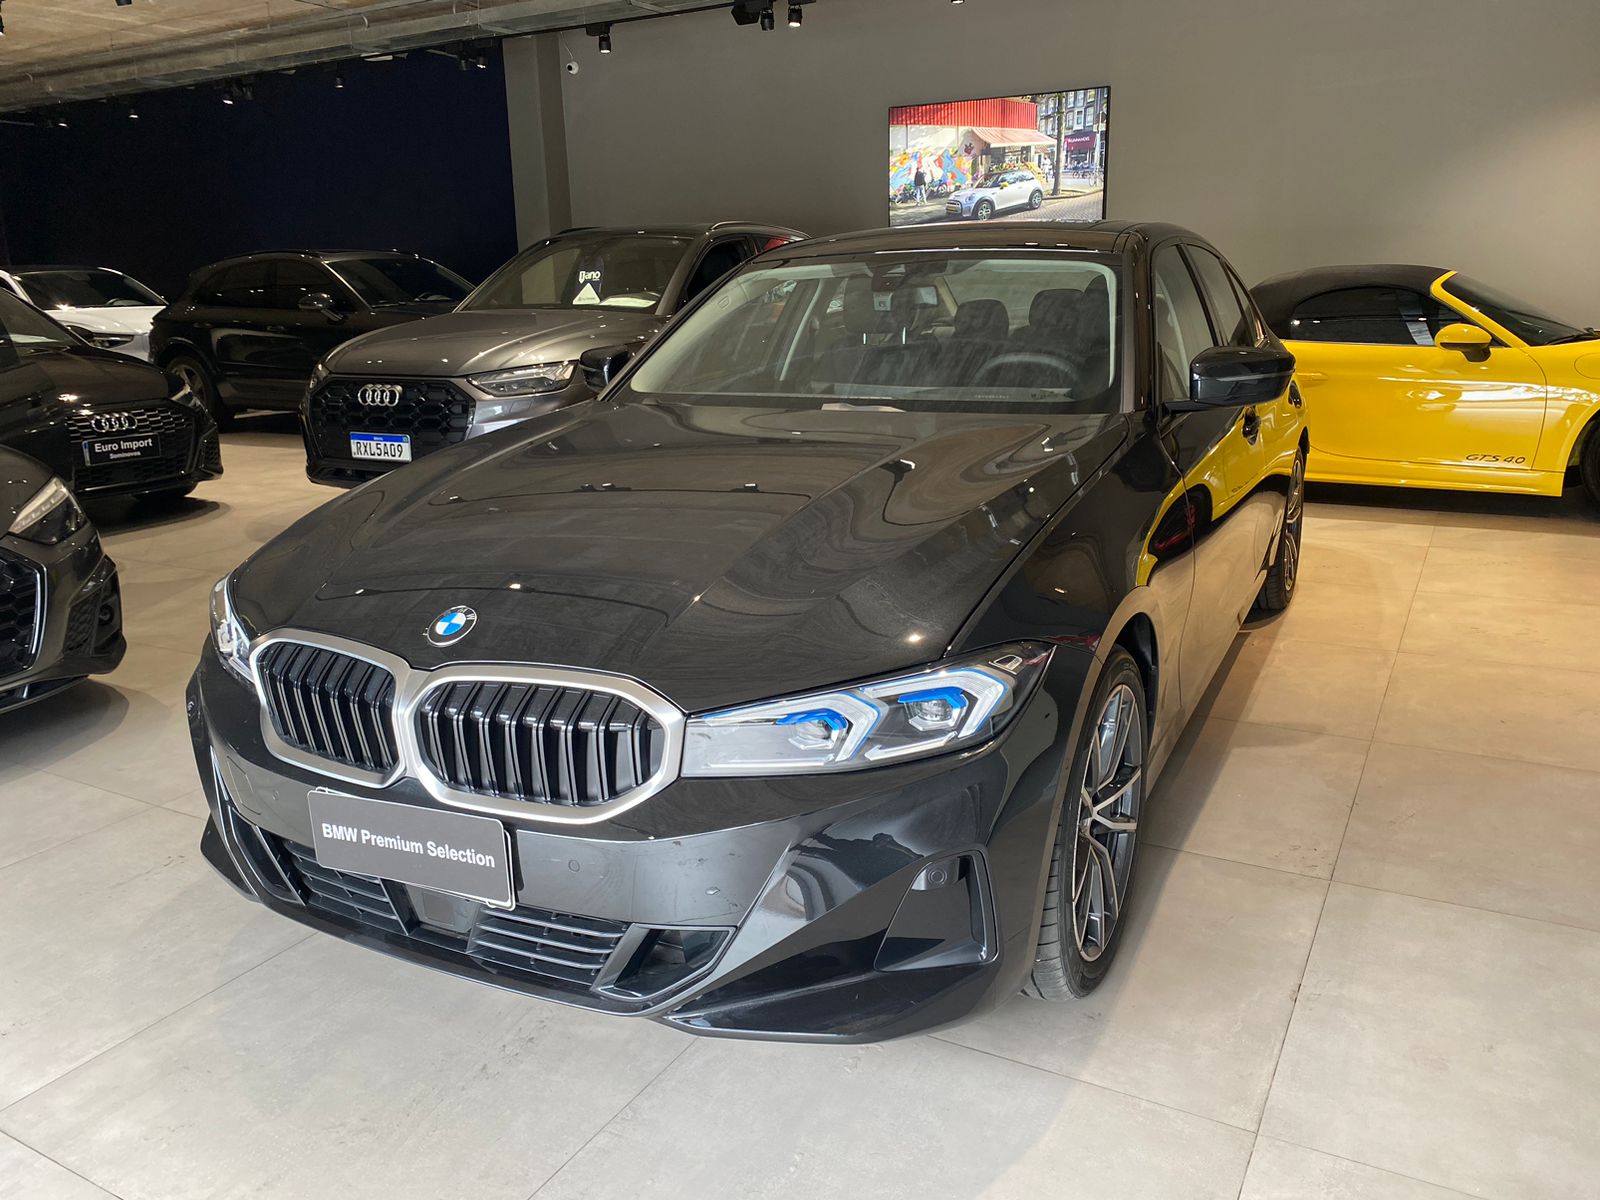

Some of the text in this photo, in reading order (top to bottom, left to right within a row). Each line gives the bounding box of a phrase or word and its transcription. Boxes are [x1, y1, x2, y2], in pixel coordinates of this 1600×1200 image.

[94, 438, 153, 453] Euro Import
[356, 441, 403, 458] RXL5A09
[1466, 453, 1500, 462] GTS
[321, 822, 496, 868] BMW Premium Selection
